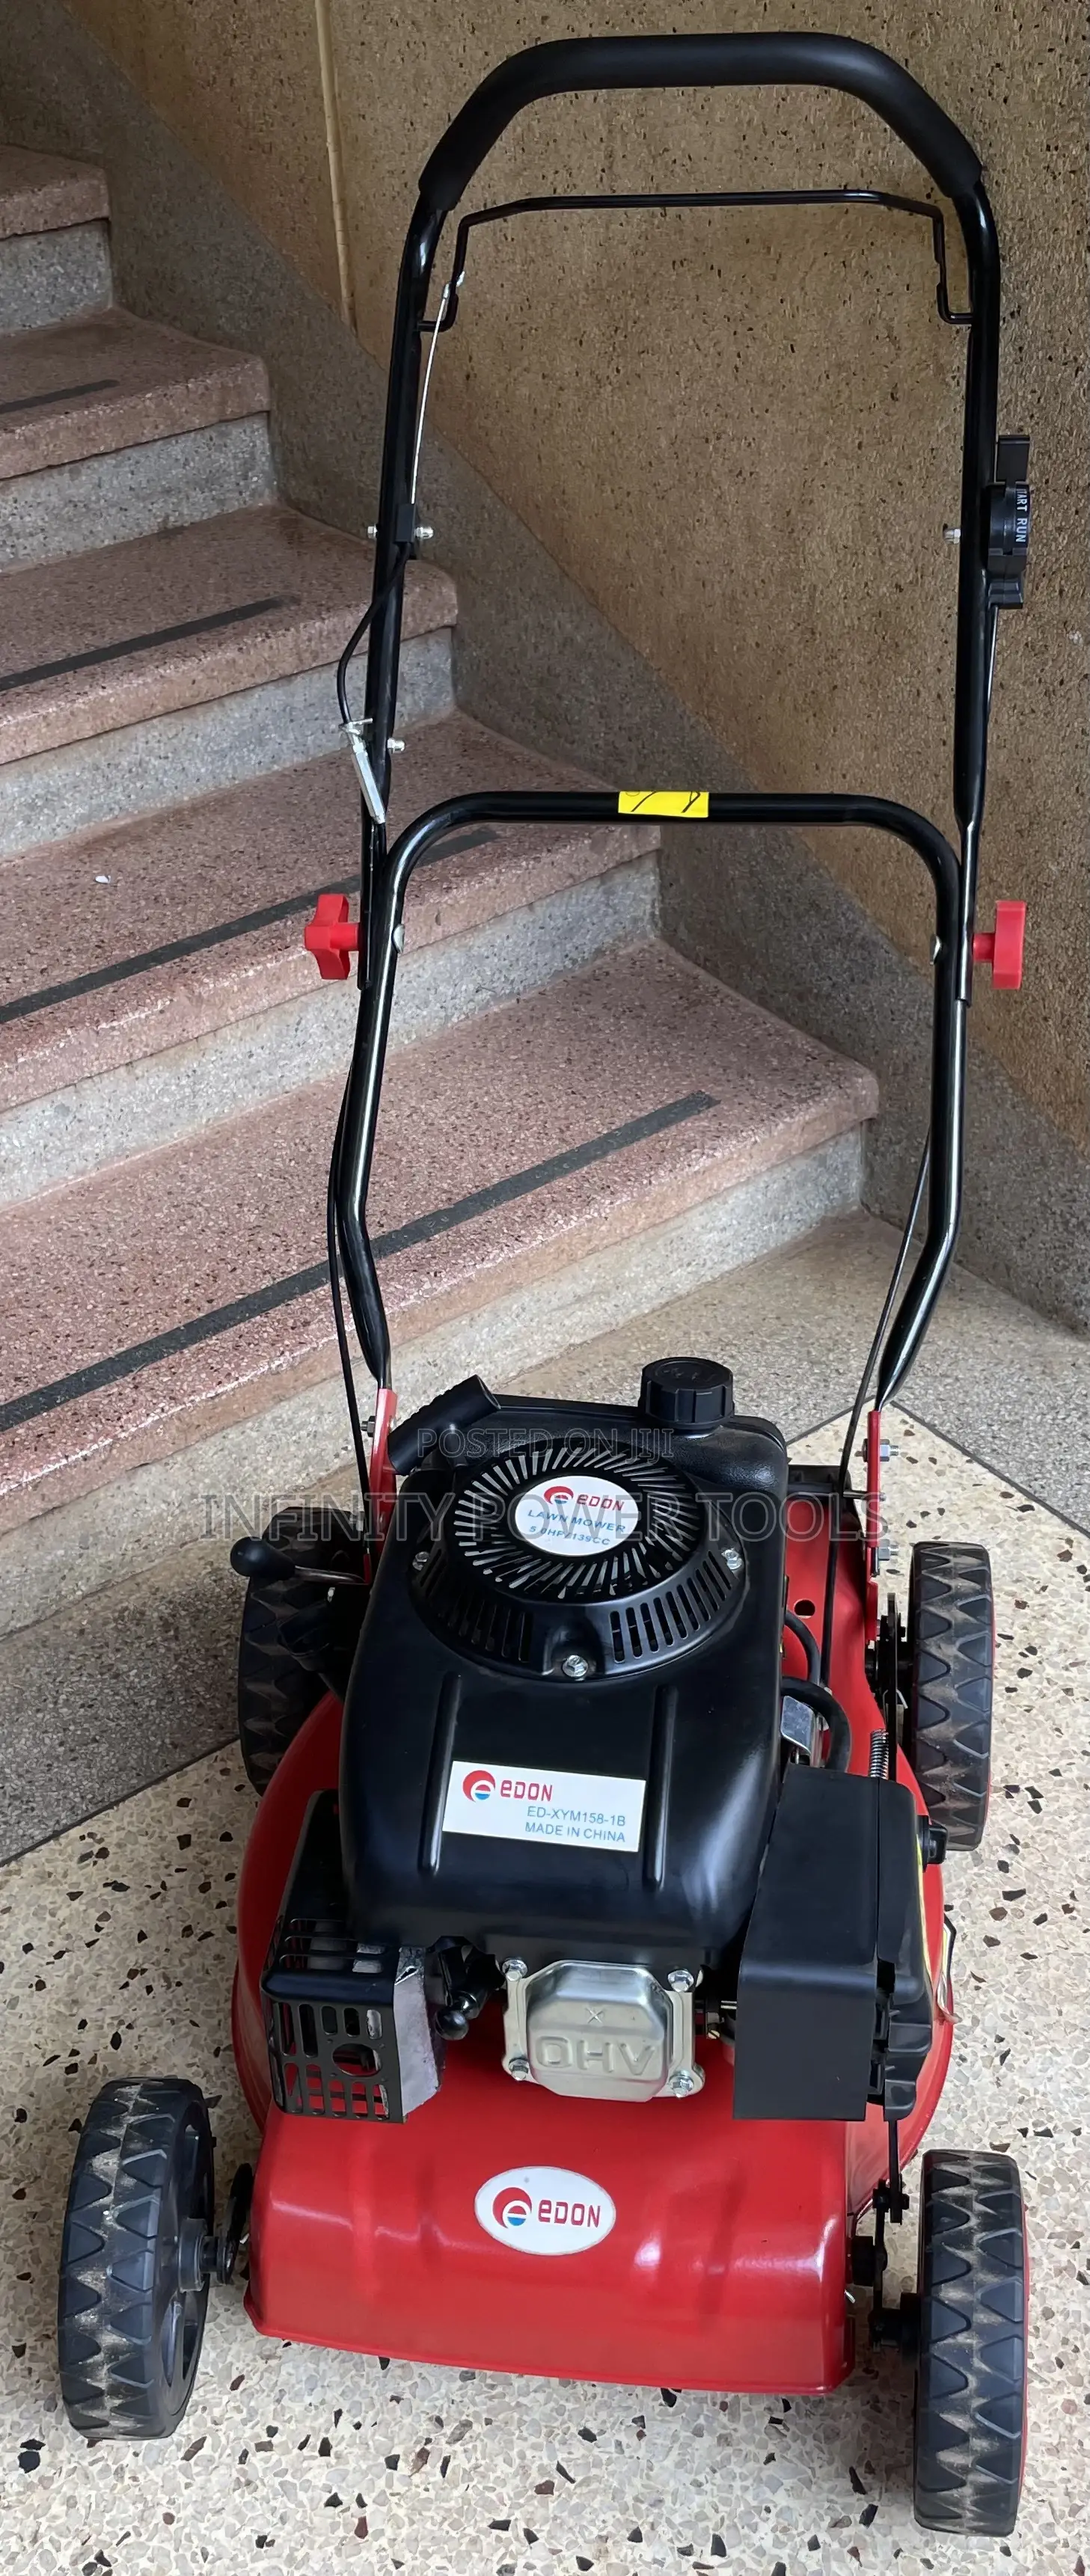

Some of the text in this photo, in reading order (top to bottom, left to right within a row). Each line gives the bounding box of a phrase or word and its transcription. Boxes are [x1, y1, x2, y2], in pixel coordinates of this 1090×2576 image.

[1015, 518, 1028, 542] RUN
[527, 1509, 626, 1533] LAWN MOWER
[527, 1806, 625, 1827] ED-XYM158-1B
[524, 1822, 625, 1842] MADE IN CHINA
[536, 2035, 657, 2076] OHV
